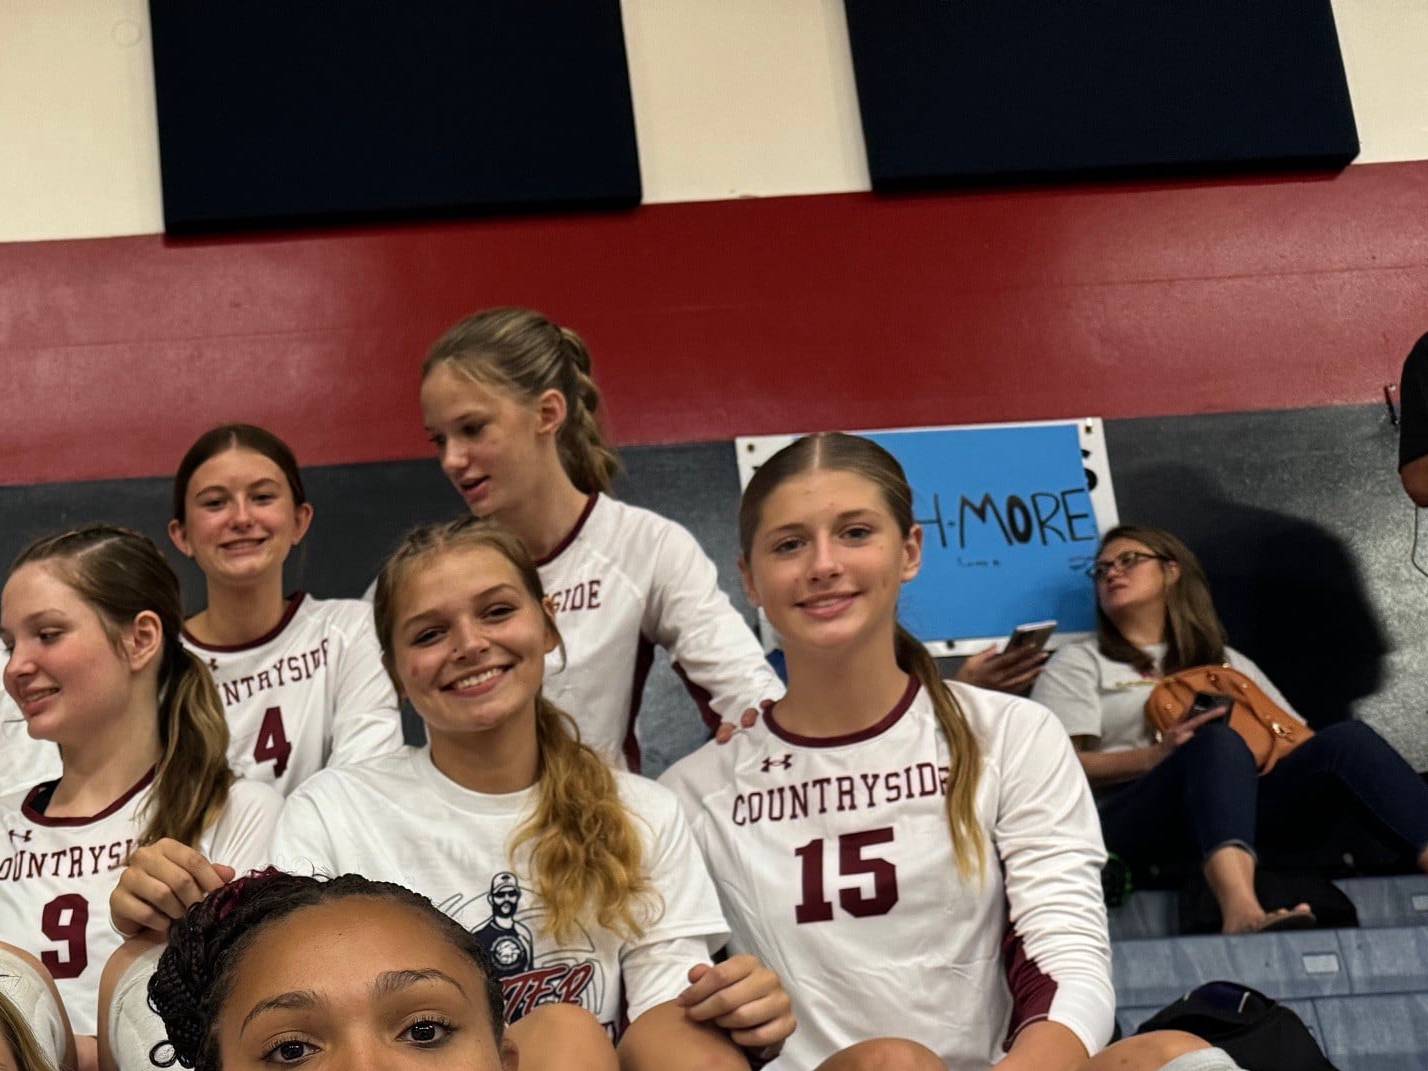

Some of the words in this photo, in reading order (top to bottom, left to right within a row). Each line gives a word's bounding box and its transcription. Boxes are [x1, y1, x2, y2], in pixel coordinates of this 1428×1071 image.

[253, 706, 292, 779] 4
[794, 826, 900, 926] 15
[40, 893, 90, 980] 9
